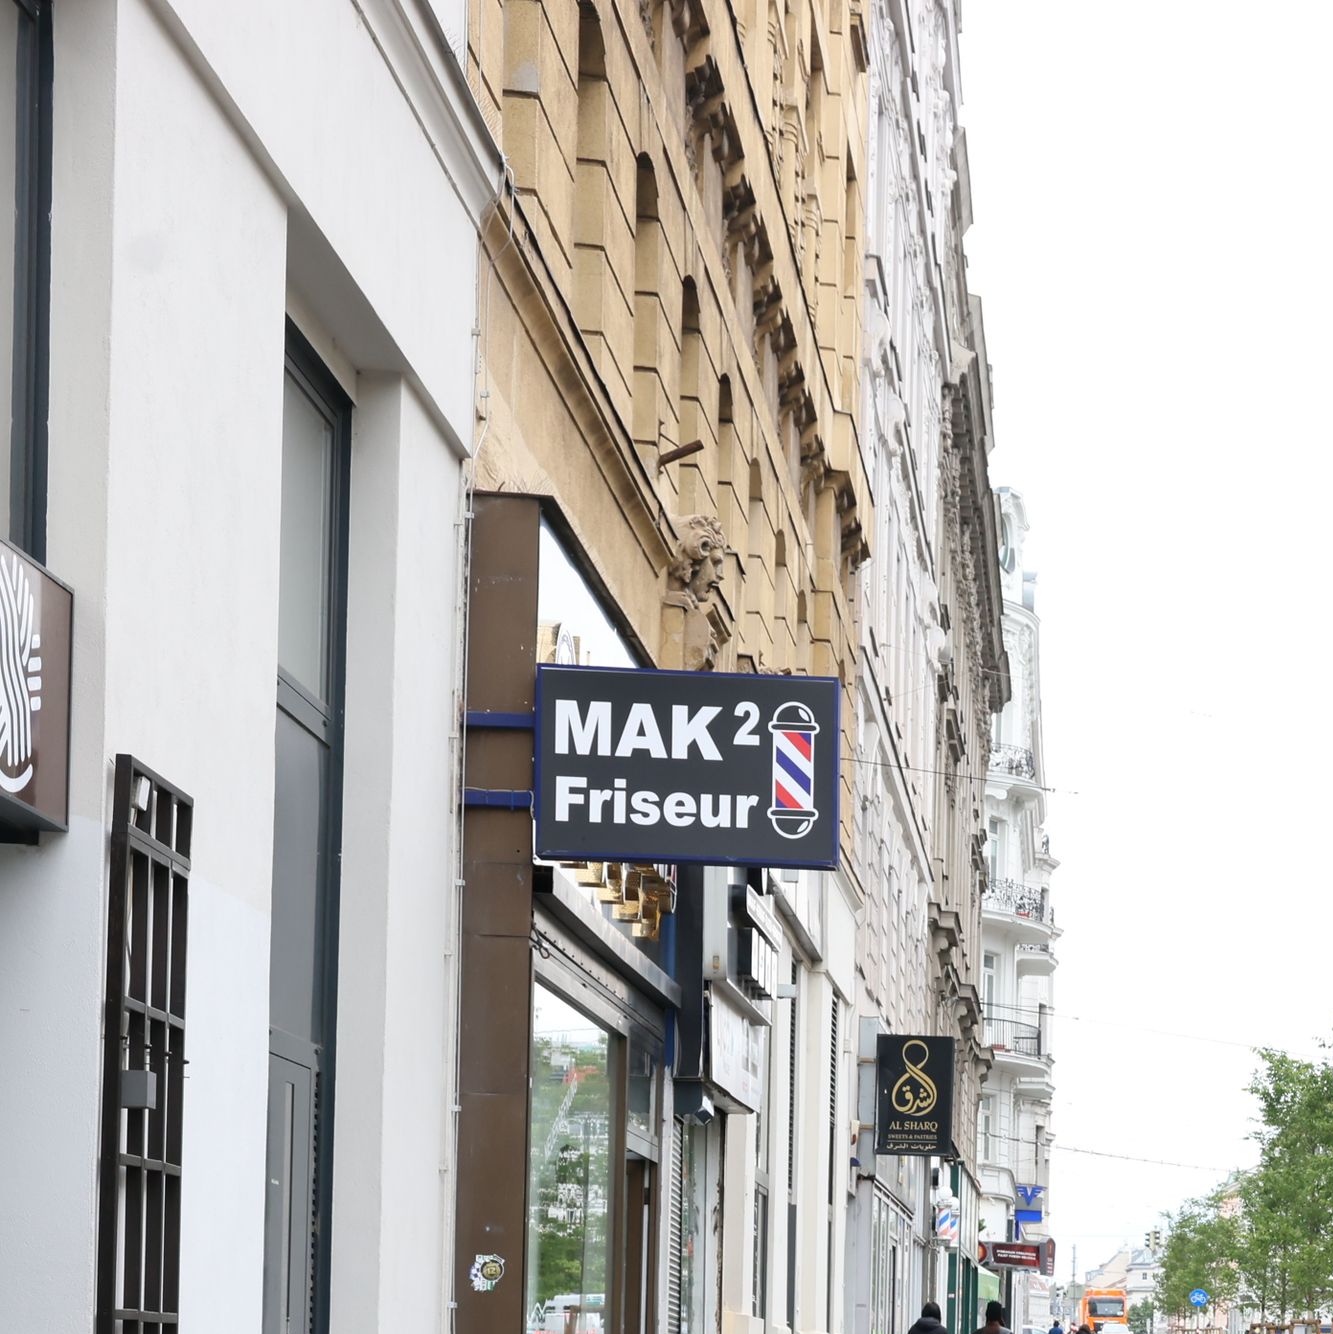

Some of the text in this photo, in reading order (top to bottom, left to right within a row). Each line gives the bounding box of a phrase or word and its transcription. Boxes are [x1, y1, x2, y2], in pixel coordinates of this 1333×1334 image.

[555, 699, 760, 761] MAK 2
[555, 775, 760, 829] Friseur
[889, 1121, 938, 1133] AL SHARQ
